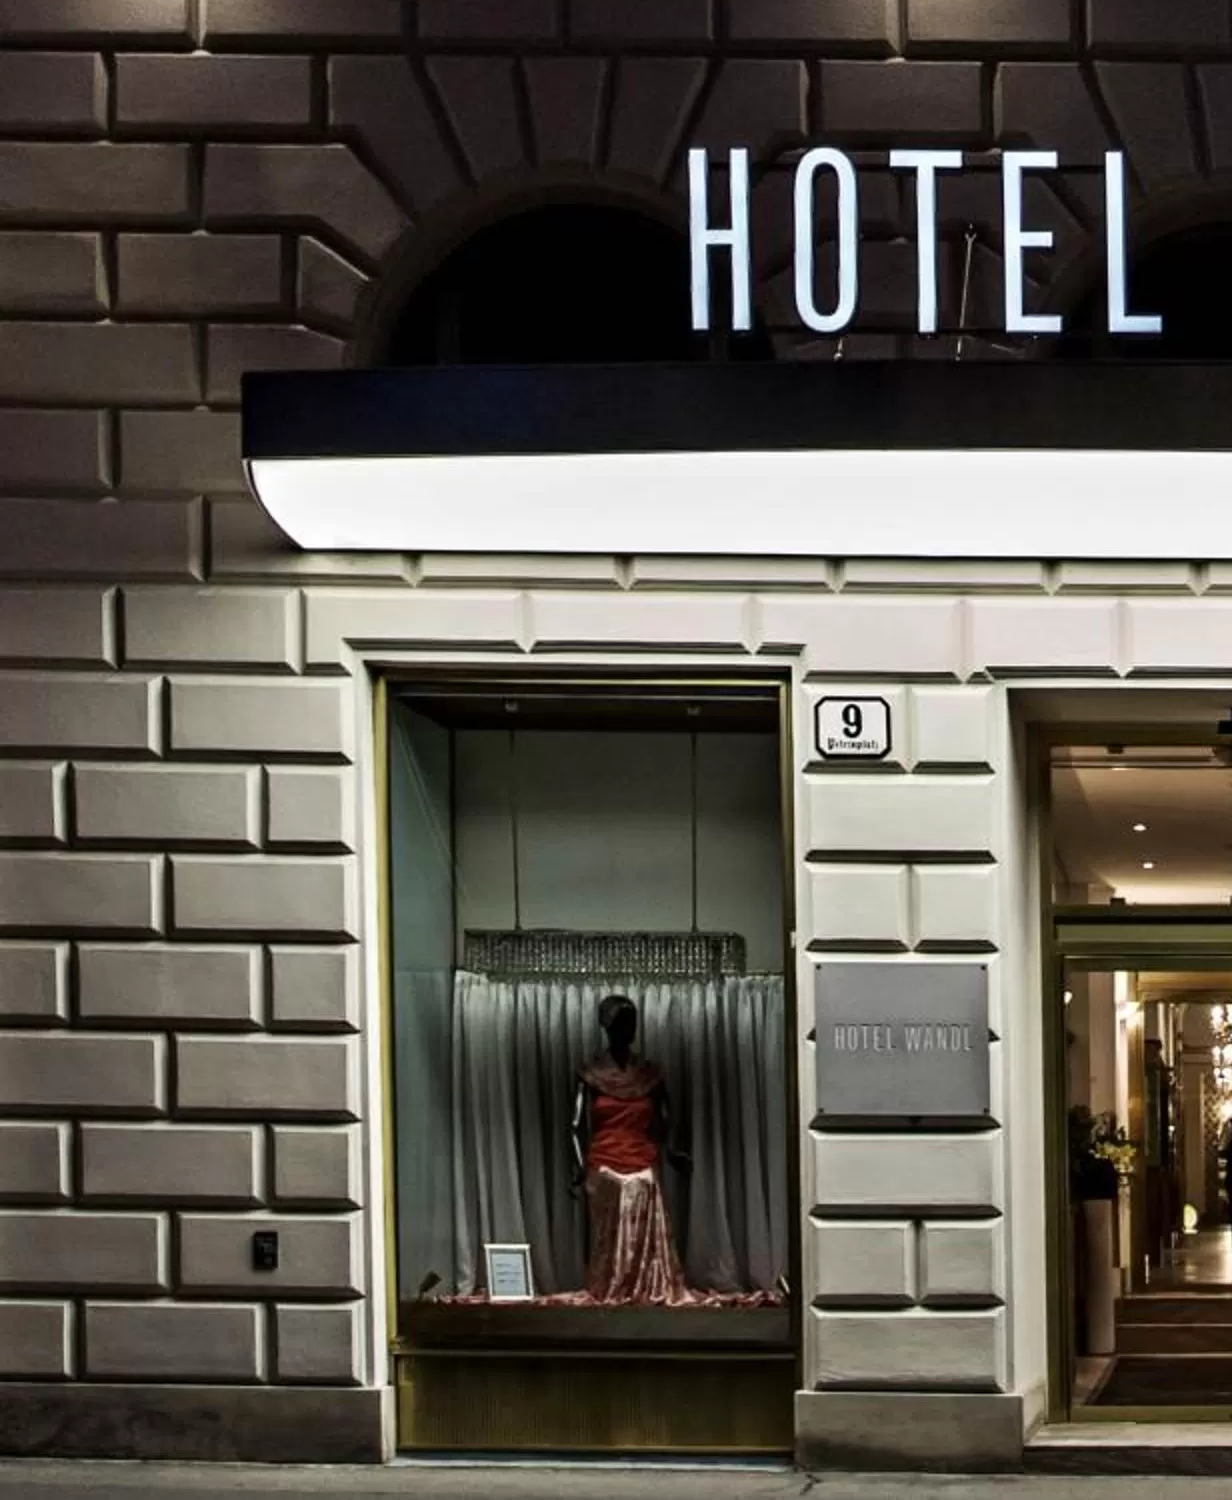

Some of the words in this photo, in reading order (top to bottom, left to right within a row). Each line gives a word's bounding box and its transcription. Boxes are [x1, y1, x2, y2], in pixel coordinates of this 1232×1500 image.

[687, 147, 1163, 334] HOTEL
[842, 704, 862, 738] 9
[834, 1023, 896, 1051] HOTEL
[904, 1022, 973, 1051] WANDL
